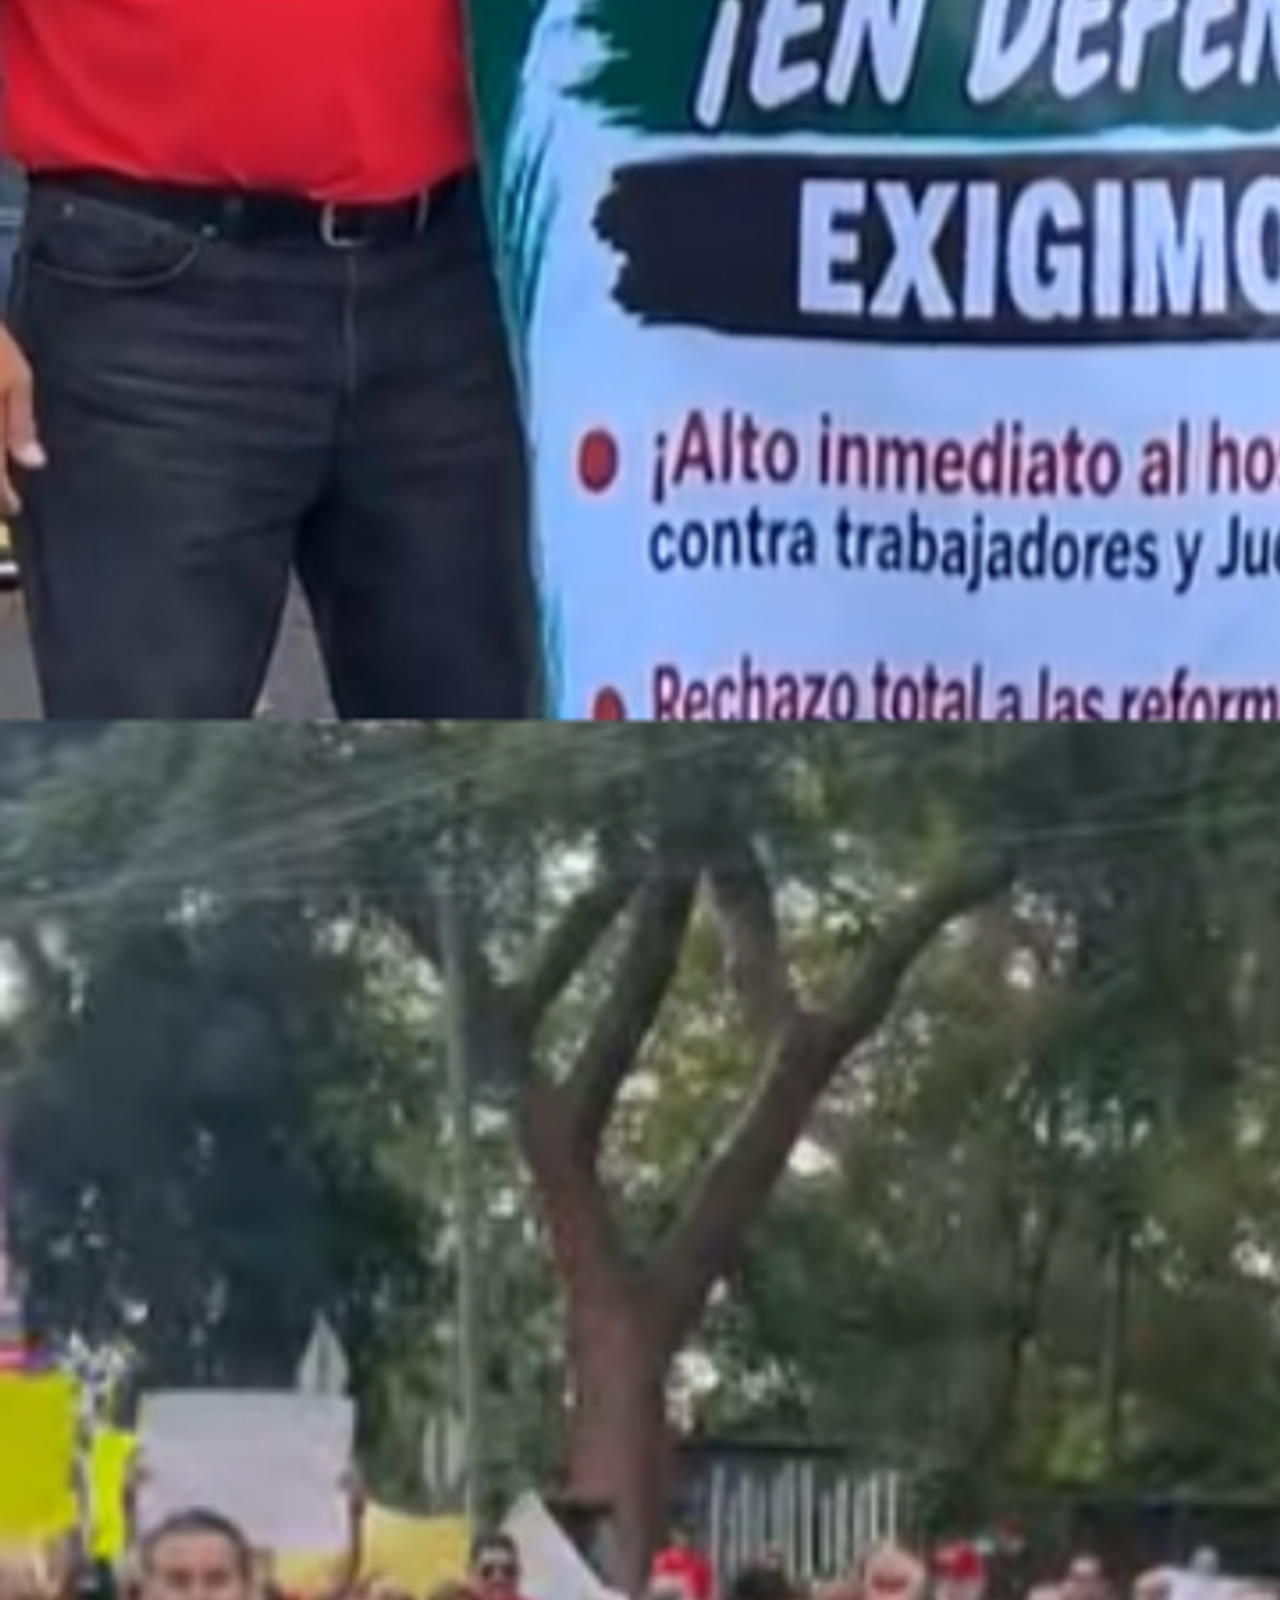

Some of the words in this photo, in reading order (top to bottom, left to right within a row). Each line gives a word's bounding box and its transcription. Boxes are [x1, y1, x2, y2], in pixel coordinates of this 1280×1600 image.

[651, 409, 799, 504] ¡Alto
[818, 412, 1122, 497] inmediato
[1139, 421, 1191, 494] al
[648, 505, 817, 572] contra
[835, 508, 1159, 594] trabajadores
[1174, 530, 1202, 594] y
[652, 654, 857, 721] Rechazo
[873, 661, 985, 721] total
[995, 684, 1021, 721] a
[1038, 666, 1101, 721] las
